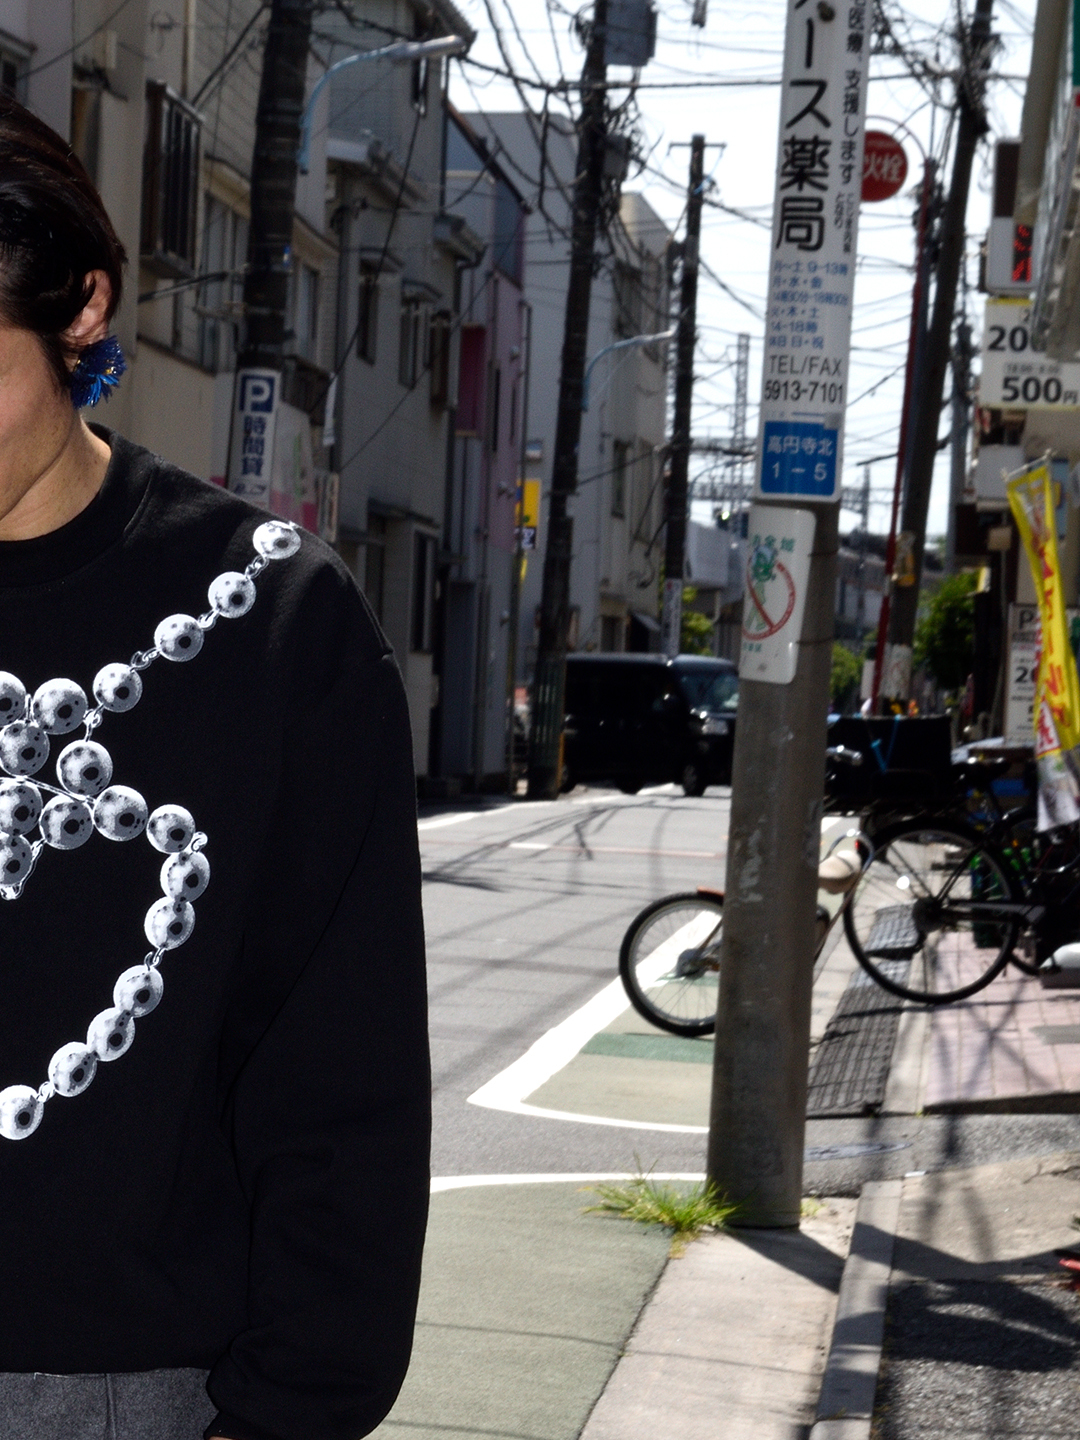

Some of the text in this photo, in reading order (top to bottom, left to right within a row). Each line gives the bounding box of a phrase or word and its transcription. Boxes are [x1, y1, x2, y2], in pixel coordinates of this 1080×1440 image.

[769, 355, 842, 376] TEL/FAX
[244, 379, 271, 412] P
[764, 380, 843, 404] 5913-7101
[767, 435, 833, 456] 高円寺北
